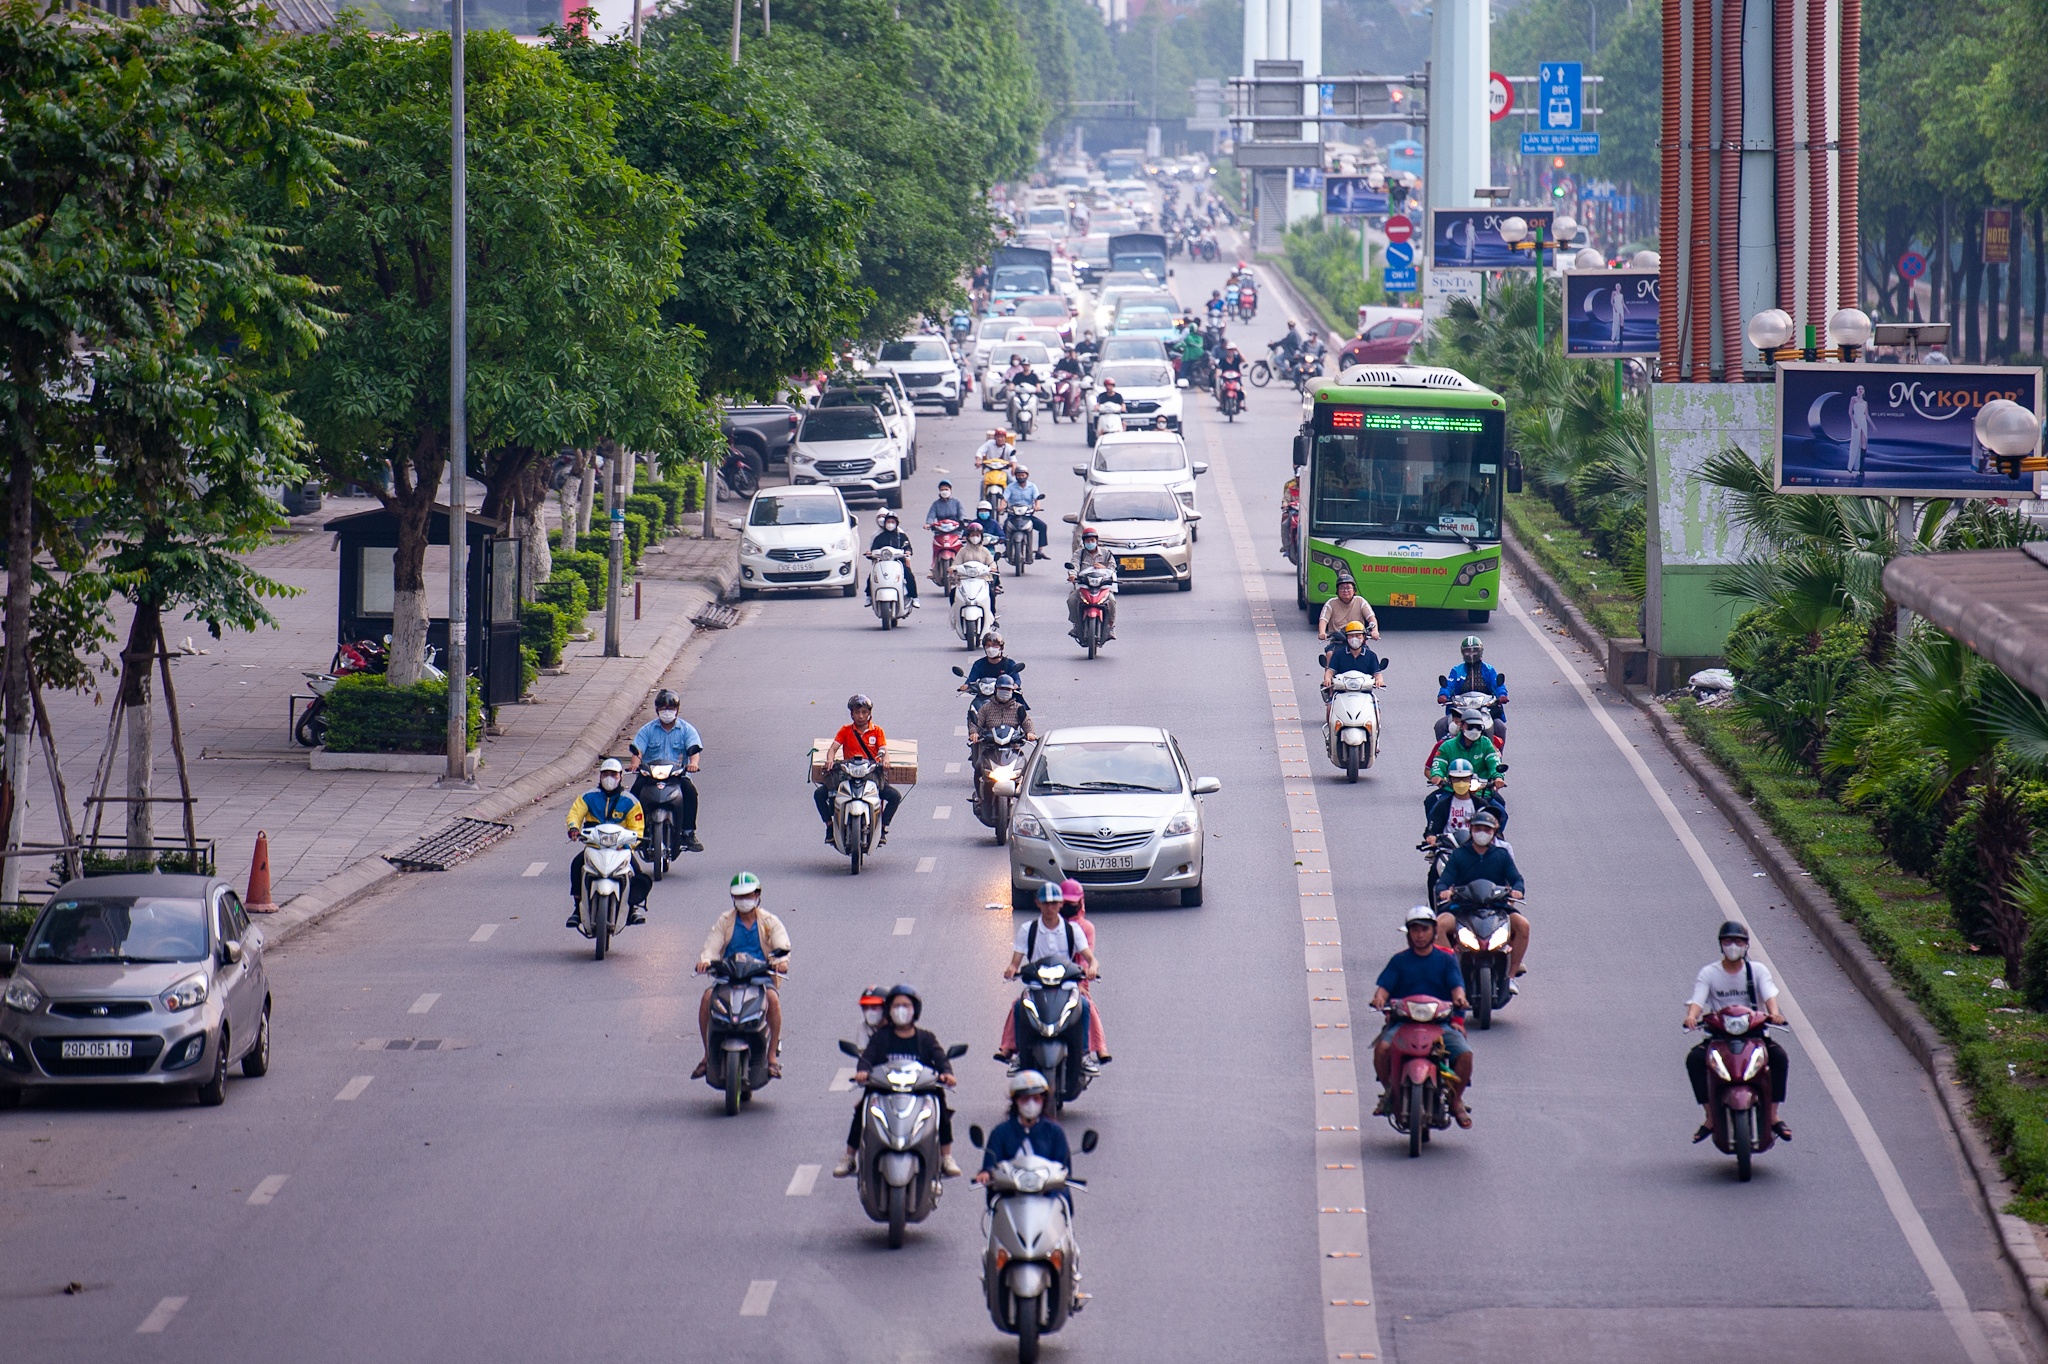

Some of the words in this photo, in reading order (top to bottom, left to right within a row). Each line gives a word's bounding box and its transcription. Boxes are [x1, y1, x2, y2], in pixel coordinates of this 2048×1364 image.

[1551, 85, 1569, 95] BRT
[1987, 227, 2010, 244] HOTEL
[1375, 565, 1389, 573] BUS
[1390, 566, 1418, 574] NHANH
[1079, 857, 1131, 869] 30A-738.15
[64, 1042, 129, 1057] 29D-051.19
